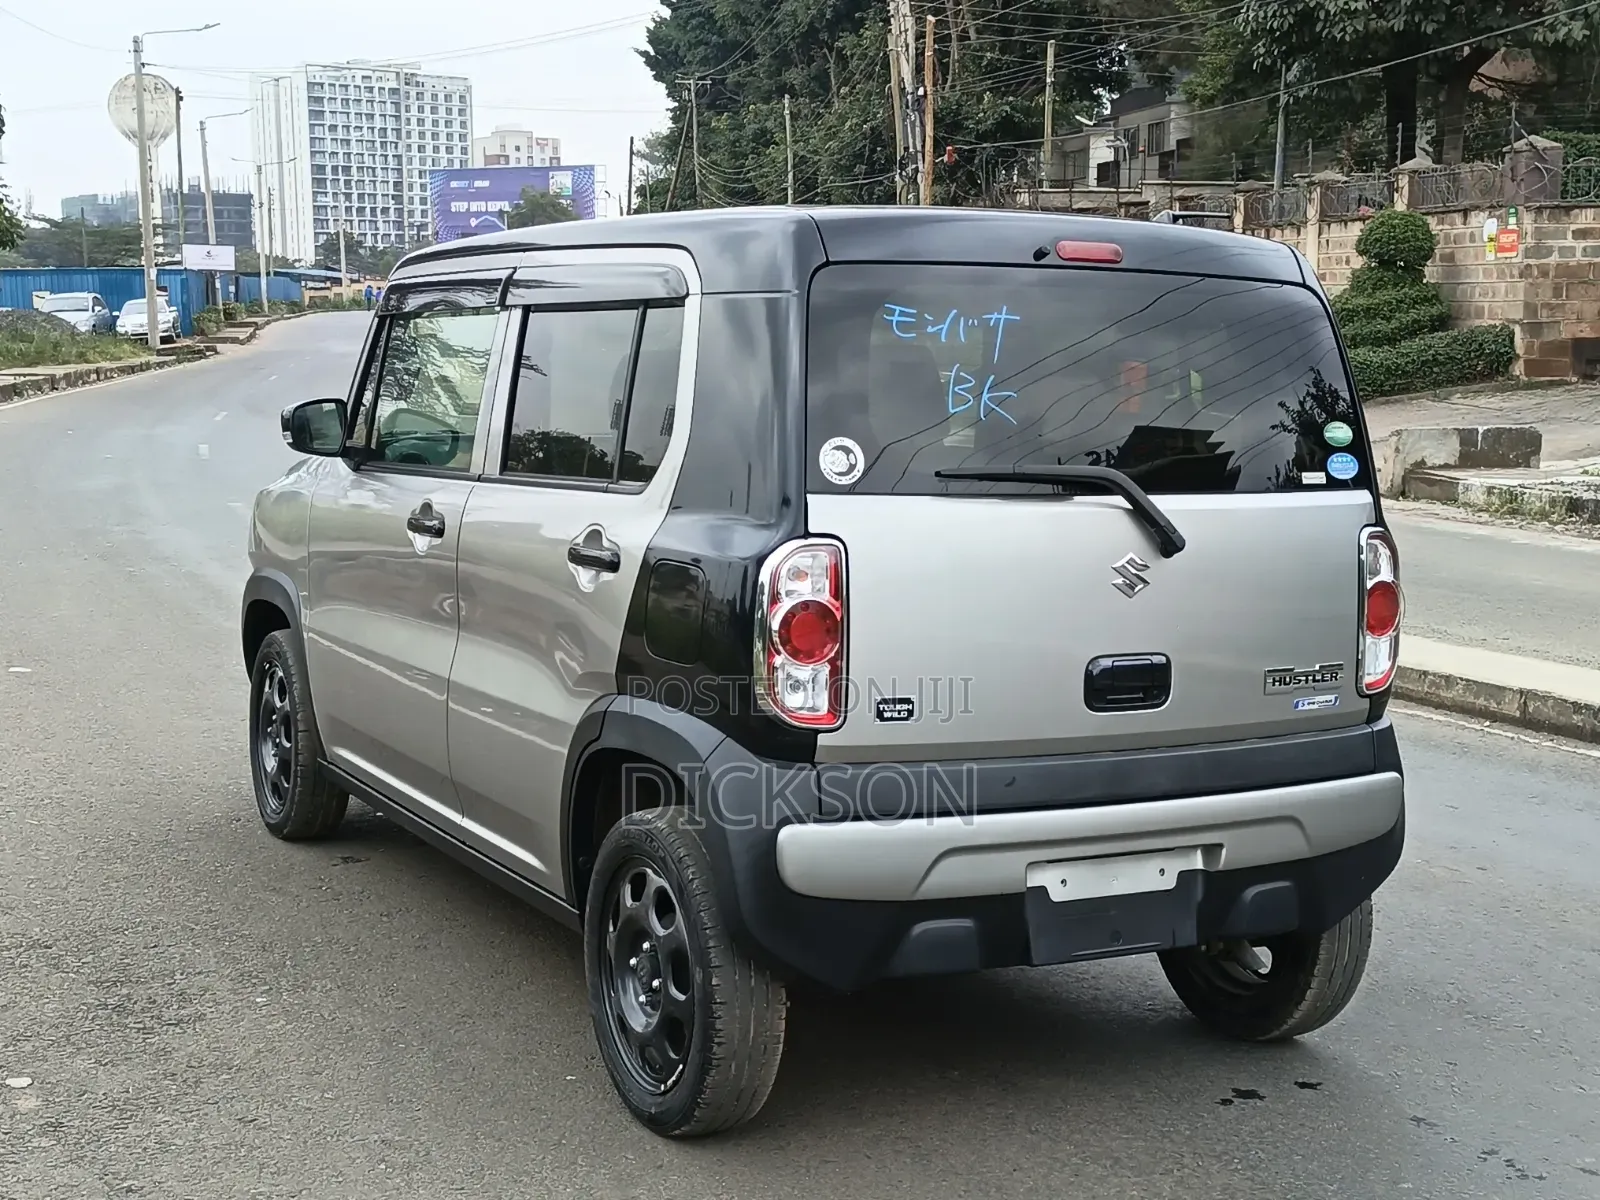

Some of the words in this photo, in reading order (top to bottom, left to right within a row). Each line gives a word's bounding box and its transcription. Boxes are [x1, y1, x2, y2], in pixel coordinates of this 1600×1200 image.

[949, 364, 1018, 425] BK
[1272, 671, 1339, 687] HUSTLER
[878, 703, 913, 711] TOUGH
